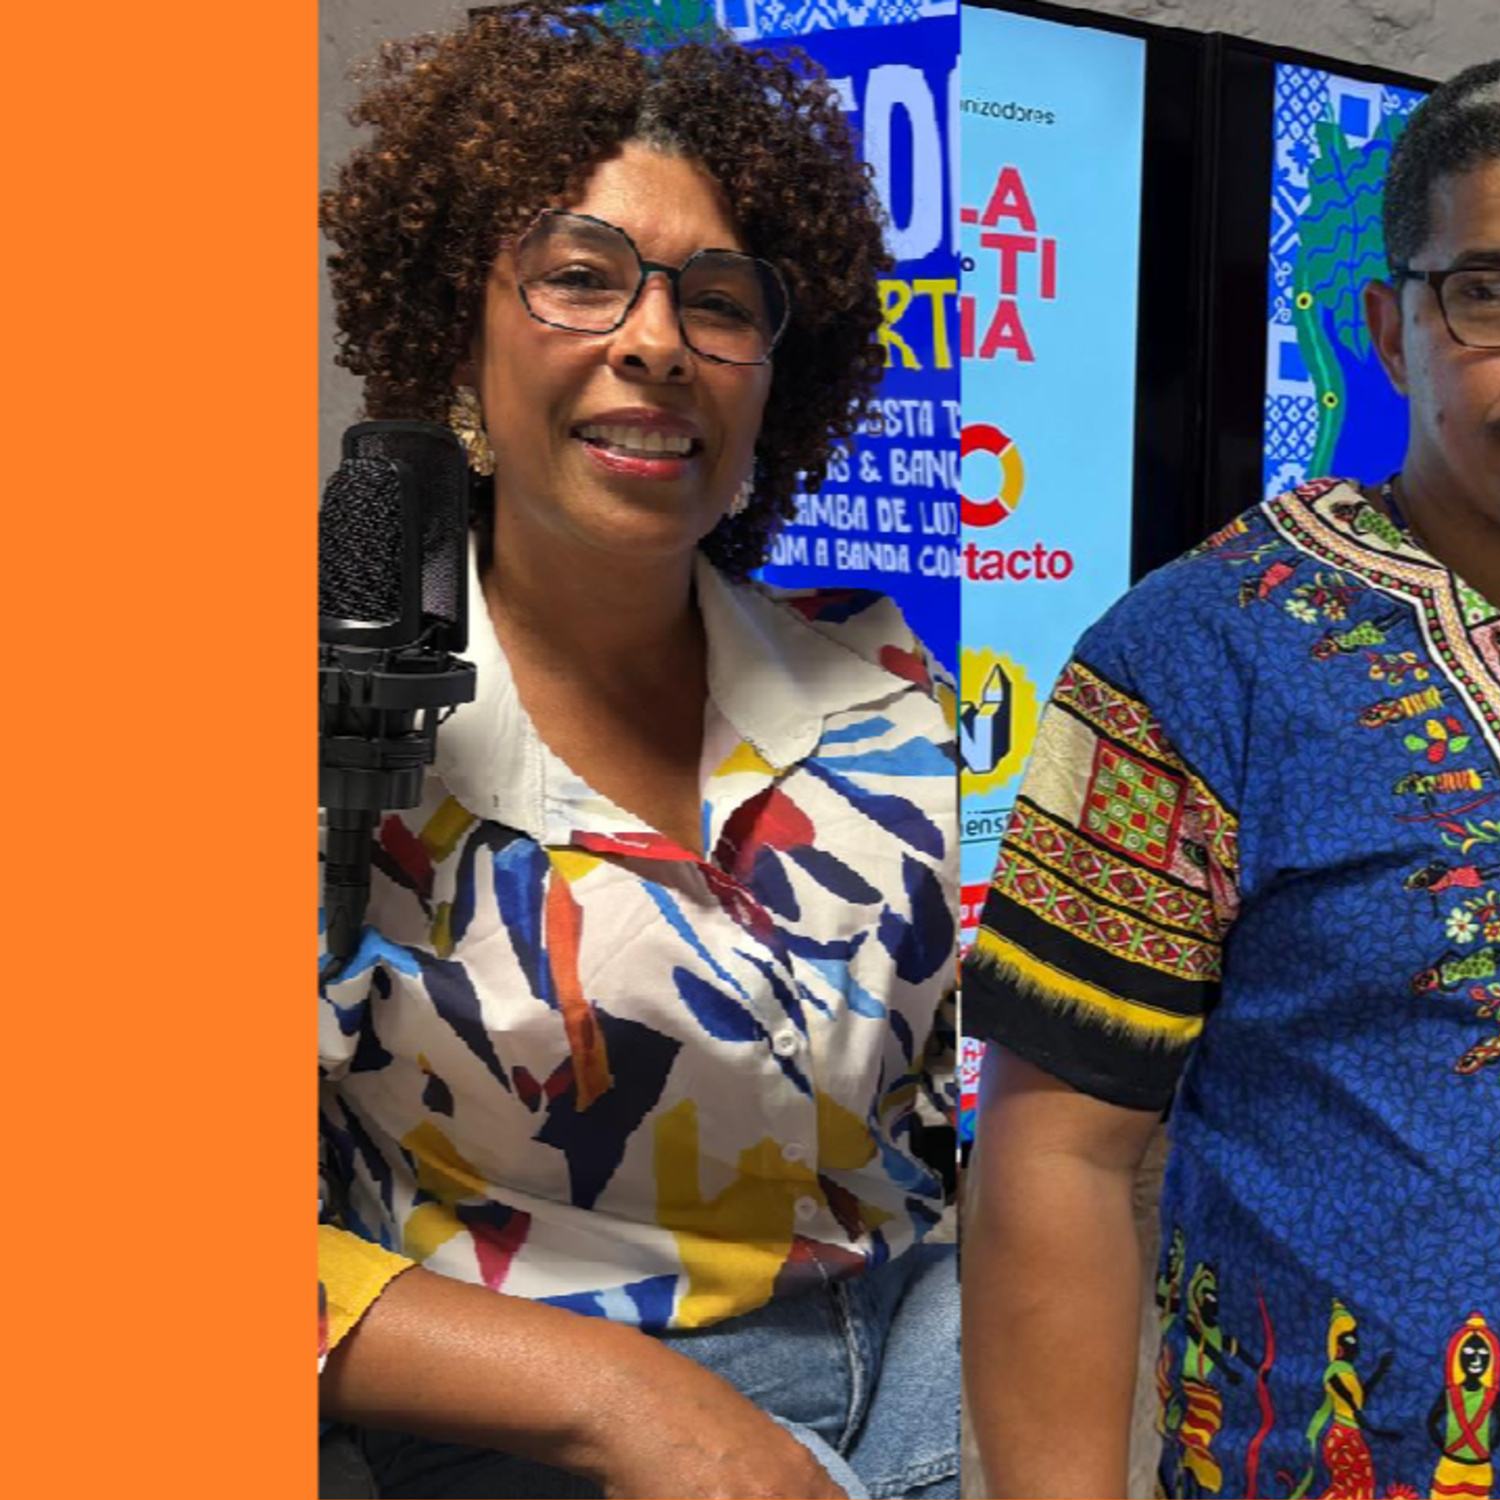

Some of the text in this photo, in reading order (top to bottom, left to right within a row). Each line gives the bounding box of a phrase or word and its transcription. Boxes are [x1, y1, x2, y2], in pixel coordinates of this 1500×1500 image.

[980, 233, 1055, 299] TI
[876, 497, 912, 533] DE
[814, 537, 829, 566] A
[835, 538, 911, 573] BANDA
